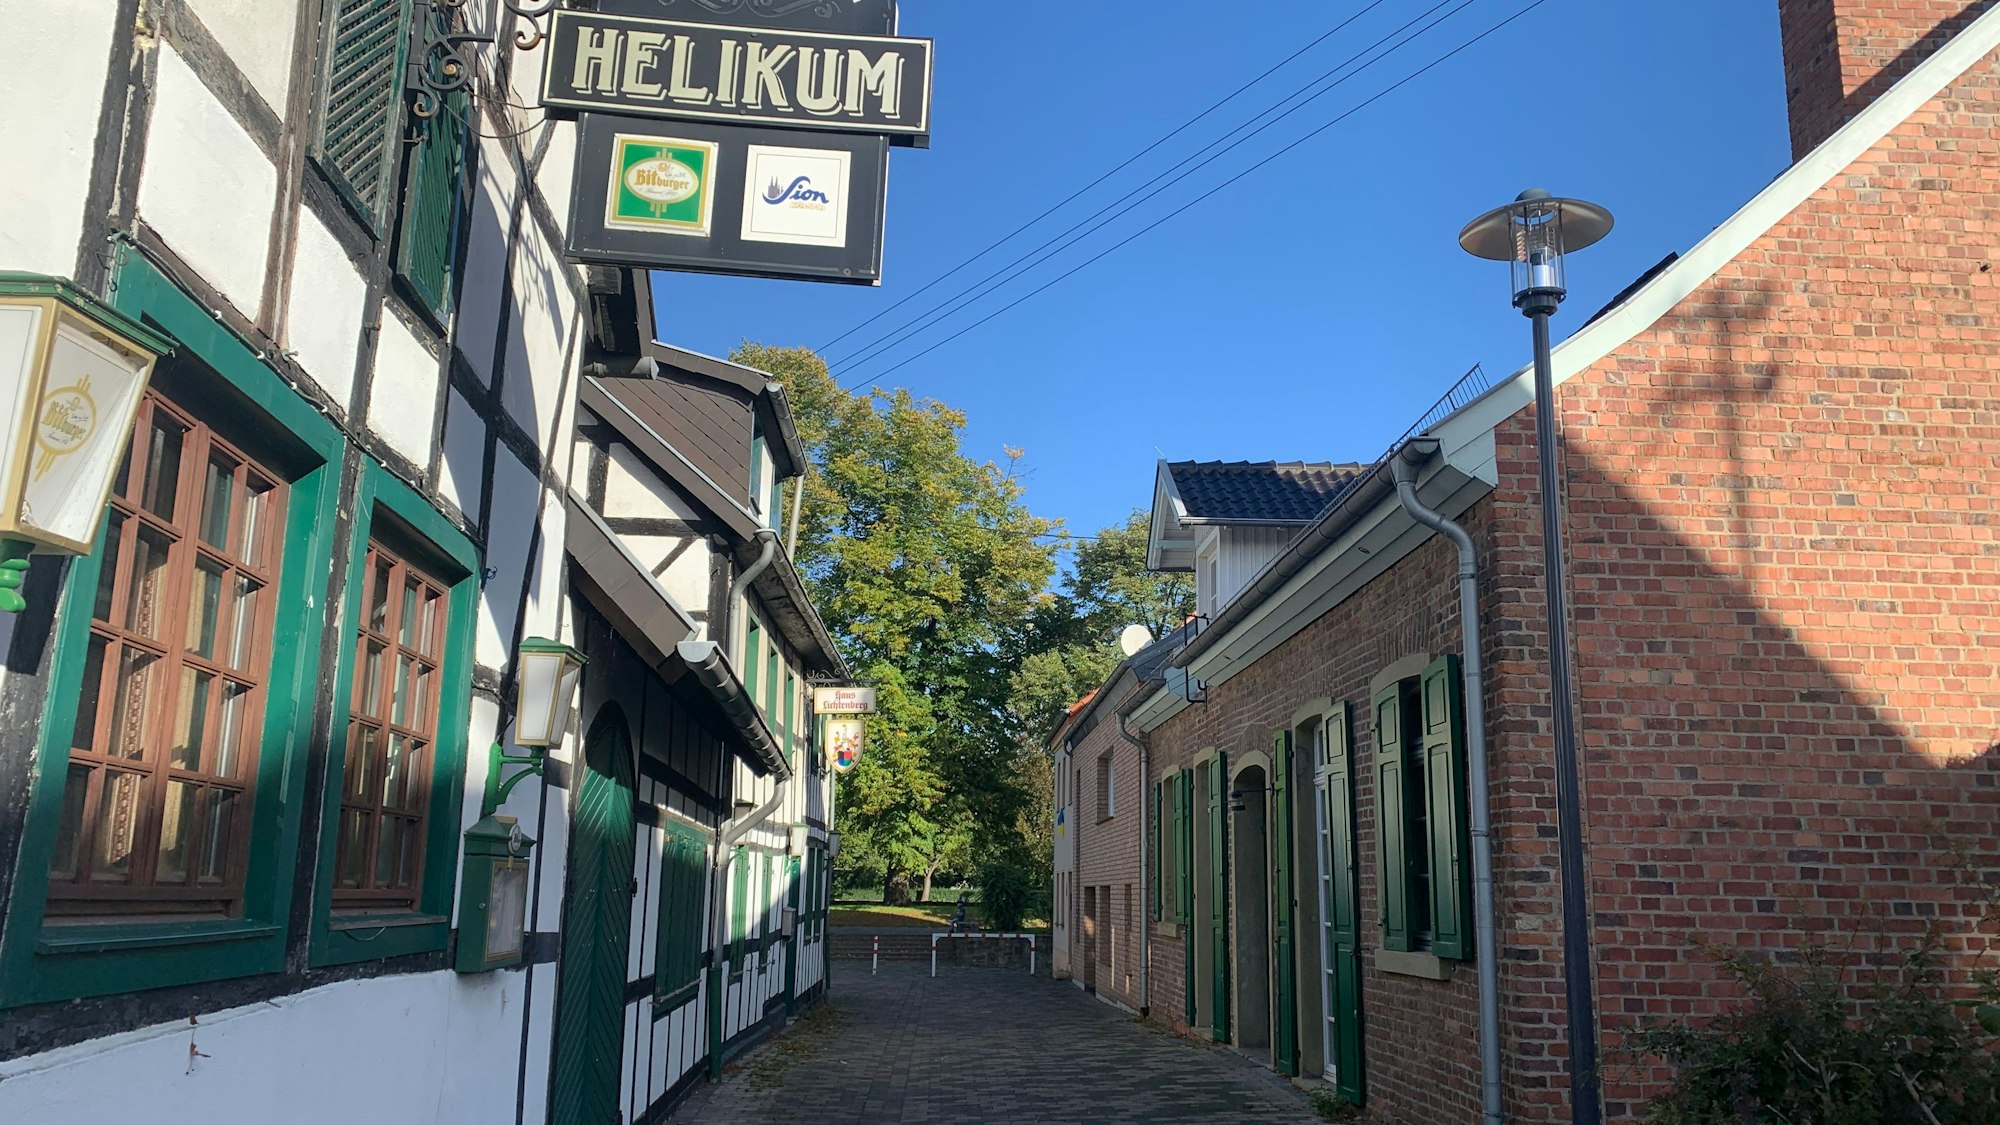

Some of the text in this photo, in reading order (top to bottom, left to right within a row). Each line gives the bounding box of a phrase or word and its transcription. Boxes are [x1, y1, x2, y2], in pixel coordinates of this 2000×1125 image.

[571, 26, 905, 119] HELIKUM
[634, 168, 690, 191] Bitburger
[762, 175, 830, 205] Sion
[39, 400, 87, 442] Bitburger
[823, 700, 868, 711] Lichtenberg
[835, 690, 856, 700] Haus
